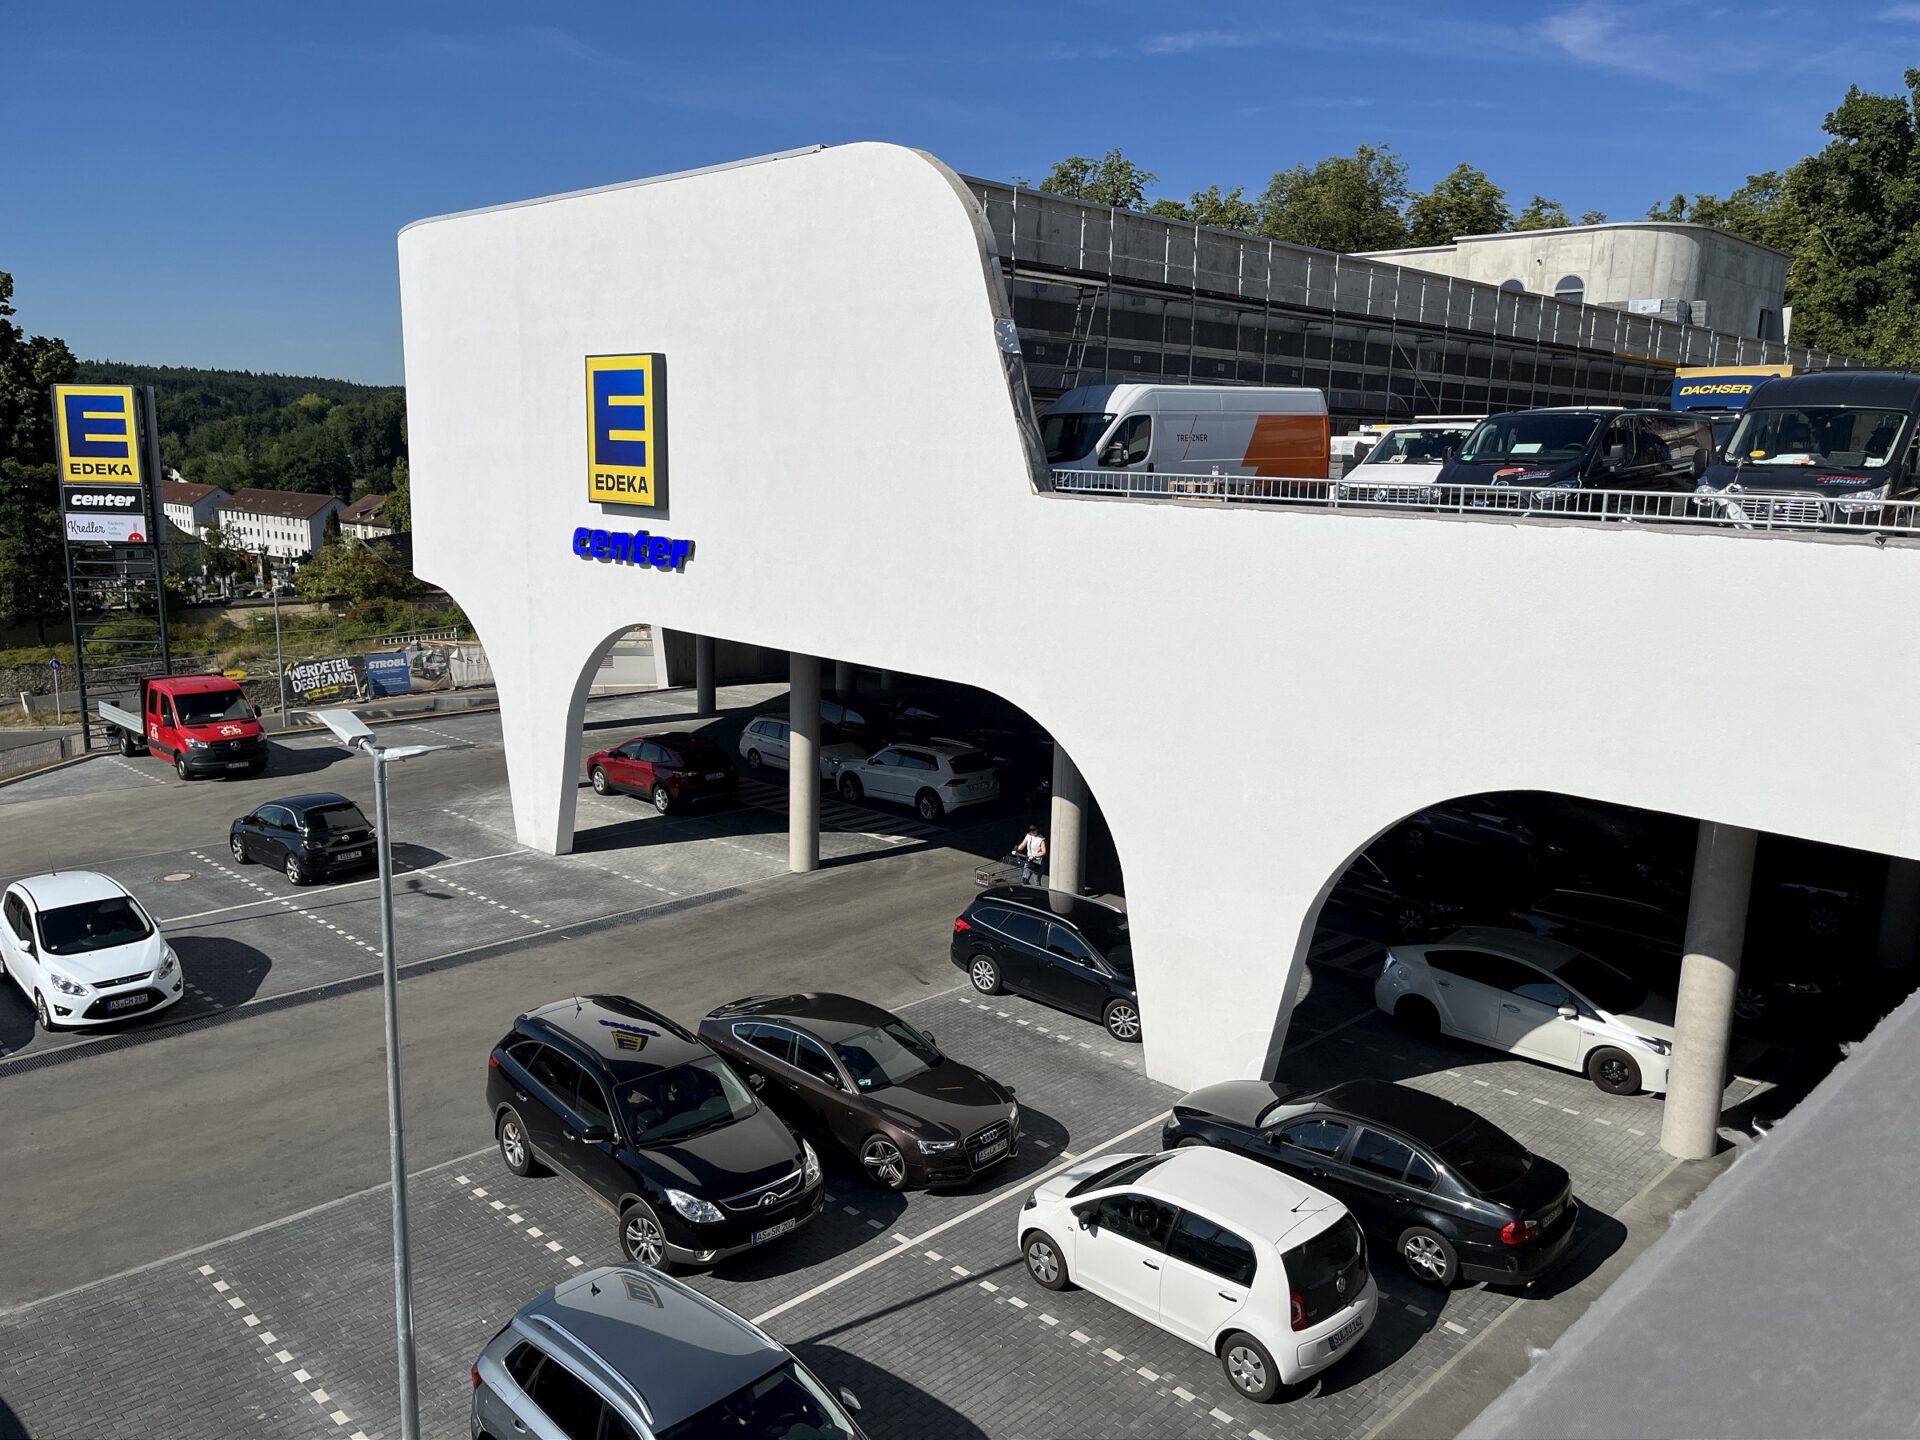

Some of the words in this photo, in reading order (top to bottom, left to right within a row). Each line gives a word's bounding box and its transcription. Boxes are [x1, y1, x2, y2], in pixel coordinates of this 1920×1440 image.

[1679, 384, 1753, 396] DACHSER
[70, 463, 133, 476] EDEKA
[595, 473, 649, 494] EDEKA
[71, 493, 136, 507] center
[67, 520, 105, 535] Kredler
[573, 526, 690, 569] center
[368, 658, 406, 670] STROBL
